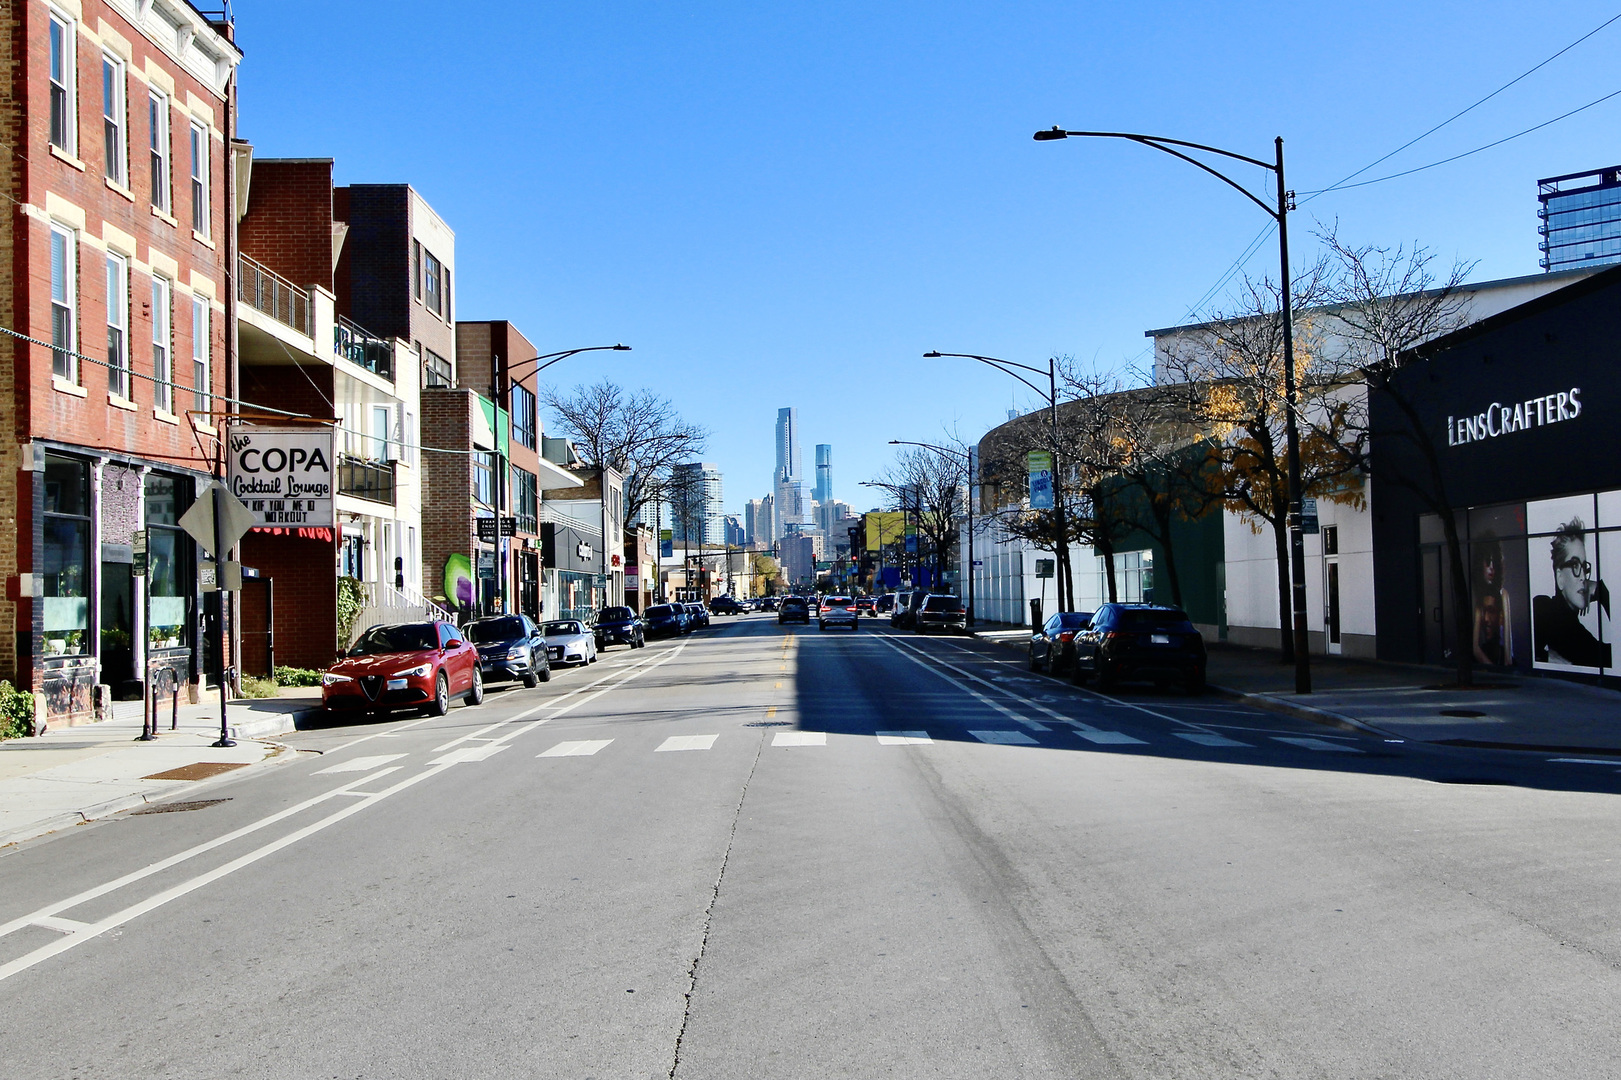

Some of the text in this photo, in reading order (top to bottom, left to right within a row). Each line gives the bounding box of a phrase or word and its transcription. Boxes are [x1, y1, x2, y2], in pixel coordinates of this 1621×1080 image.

[230, 435, 251, 453] the
[239, 448, 329, 473] COPA
[233, 475, 329, 498] Cocktail Lounge
[269, 500, 285, 511] YOU
[264, 511, 308, 523] WORKOUT
